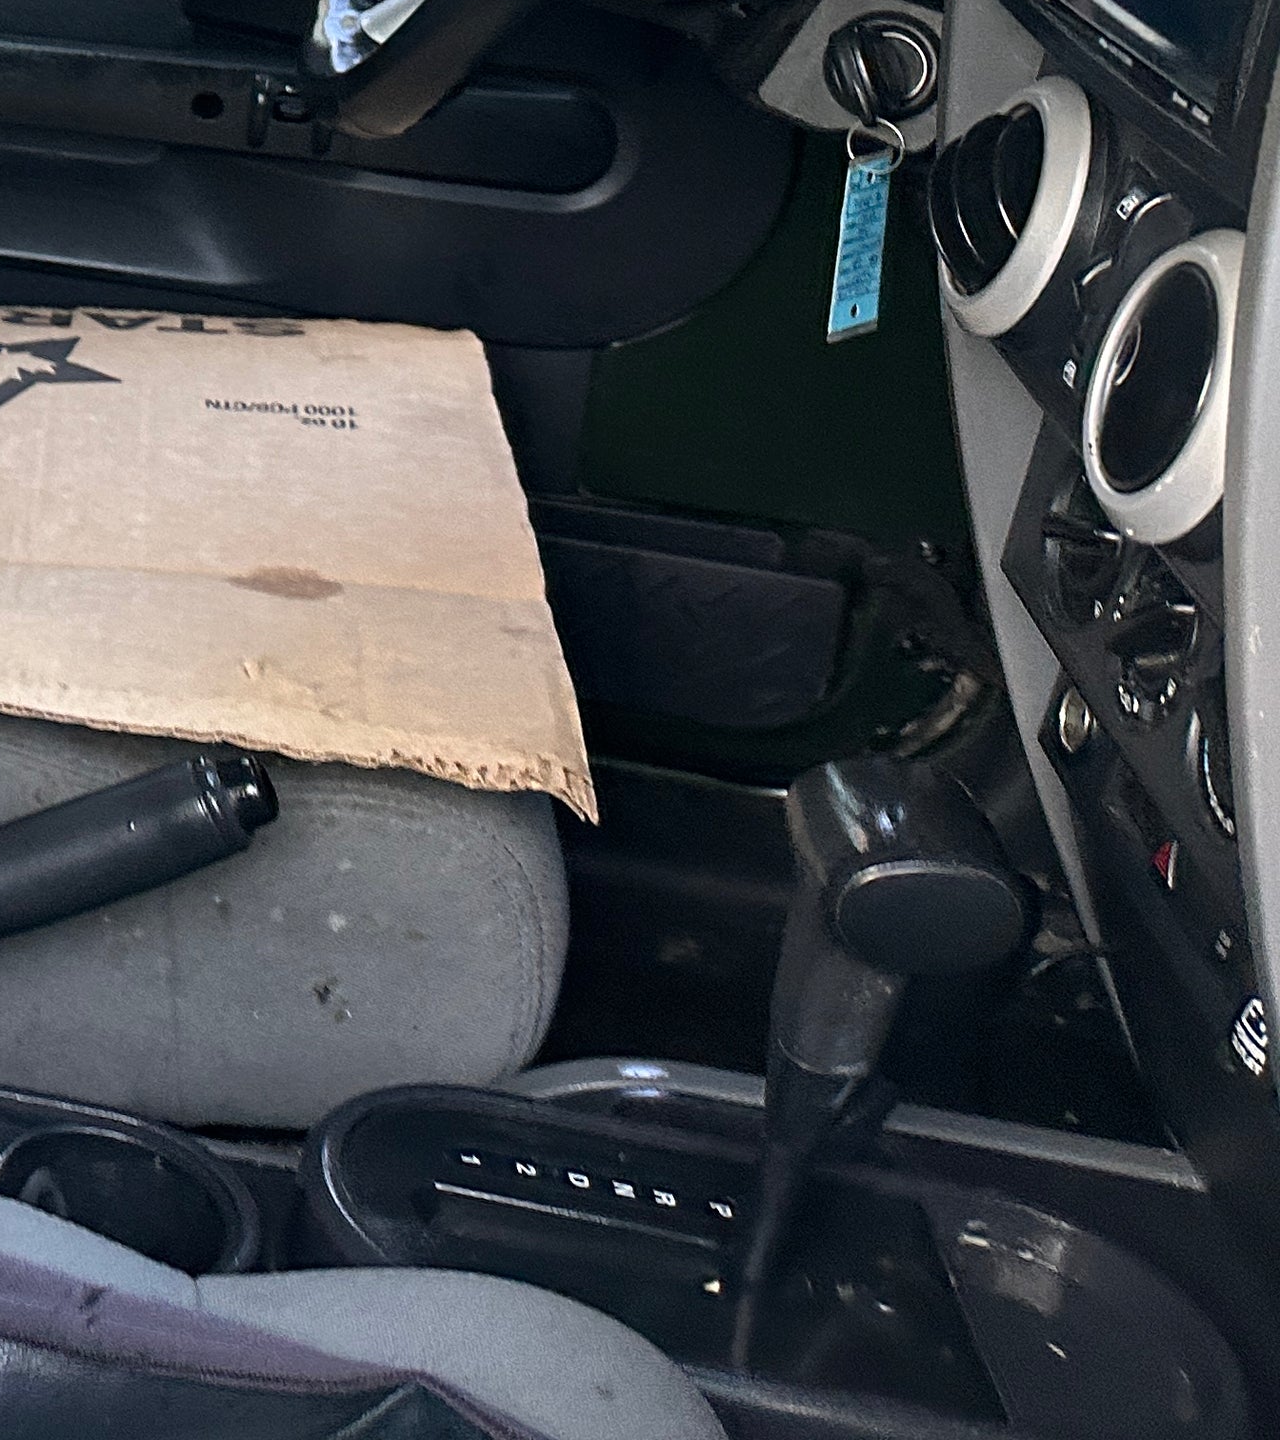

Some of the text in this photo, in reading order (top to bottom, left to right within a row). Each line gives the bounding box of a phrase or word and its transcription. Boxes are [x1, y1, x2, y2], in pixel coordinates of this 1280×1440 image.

[303, 404, 358, 417] 1000
[515, 1161, 537, 1177] 2
[568, 1171, 590, 1189] D
[652, 1188, 676, 1208] R
[708, 1201, 733, 1219] P
